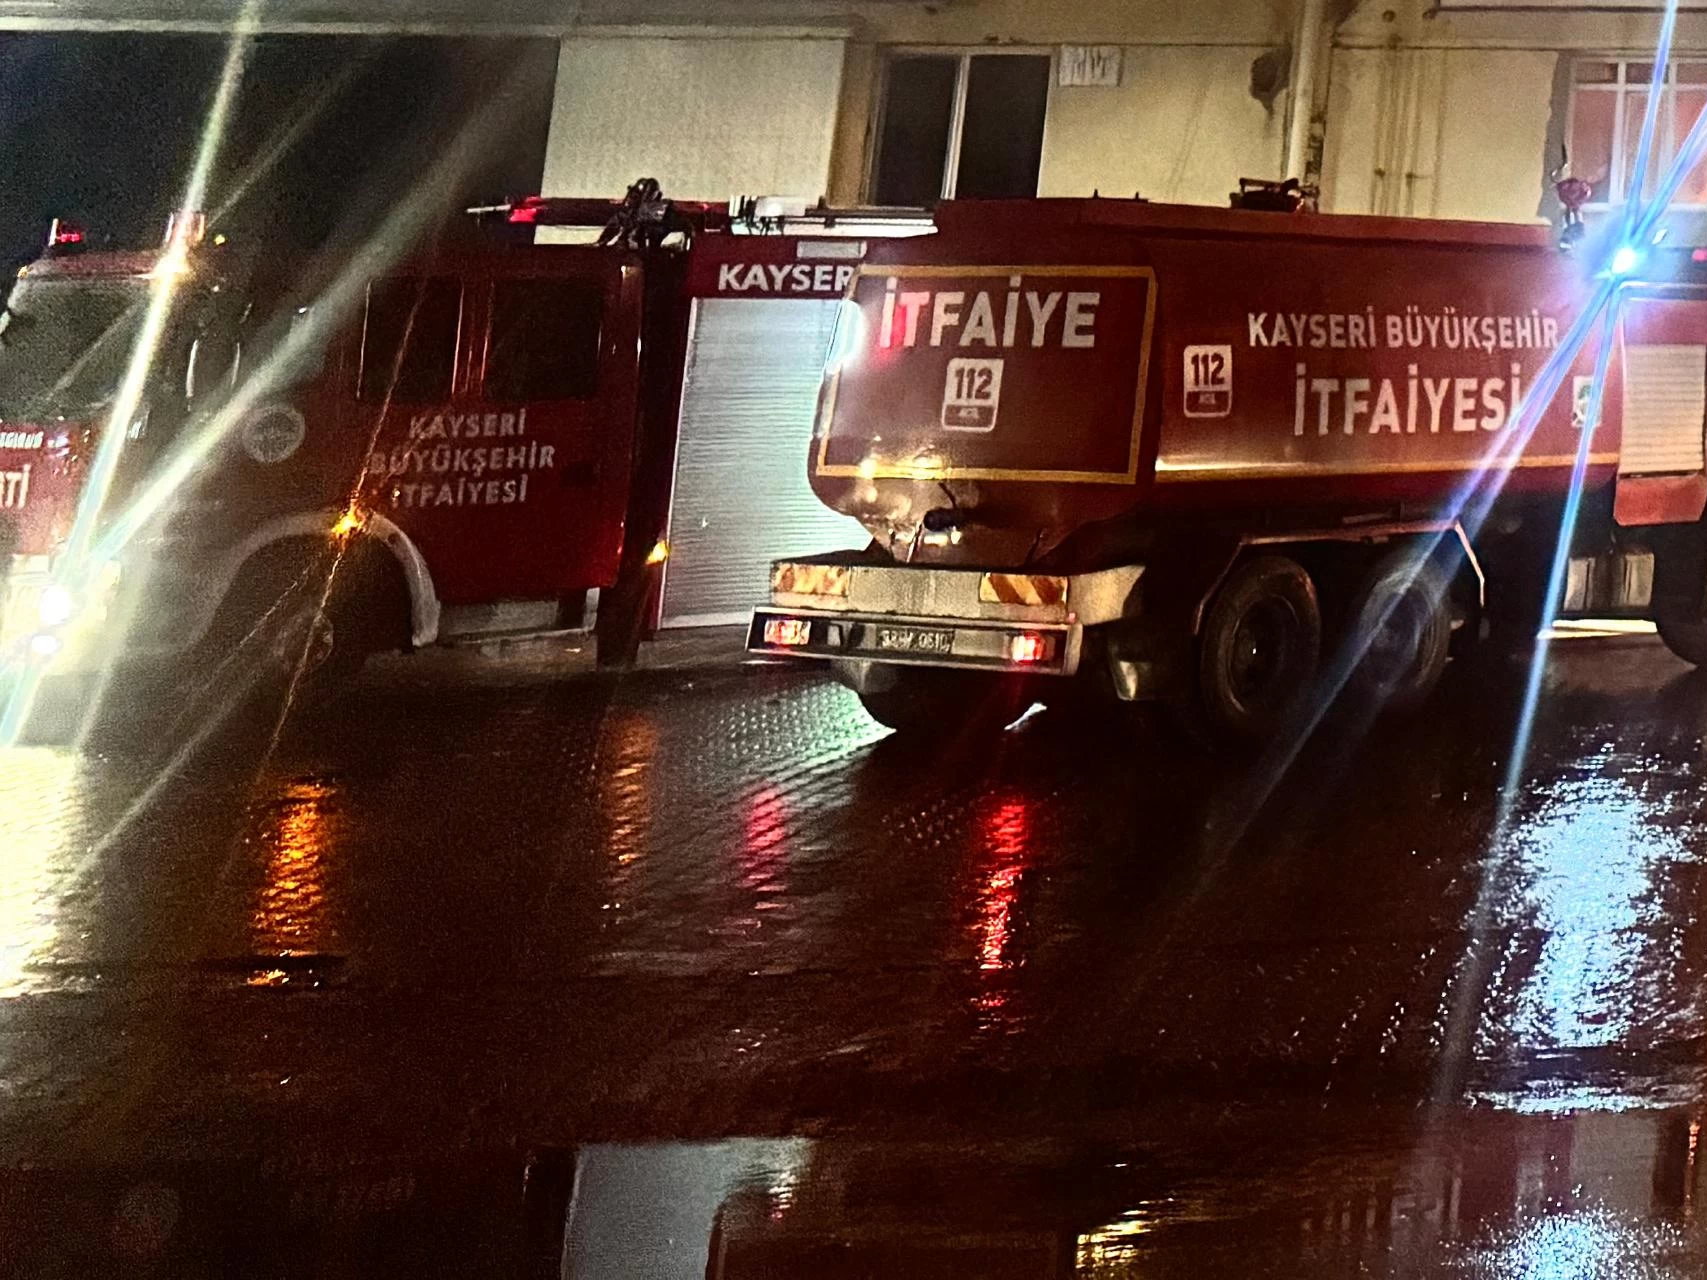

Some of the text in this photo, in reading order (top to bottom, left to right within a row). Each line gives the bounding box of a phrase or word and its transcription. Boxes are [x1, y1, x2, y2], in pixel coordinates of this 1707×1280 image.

[717, 262, 856, 293] KAYSER
[879, 275, 1101, 349] İTFAİYE
[1247, 306, 1560, 354] KAYSERİ BÜYÜKŞEHİR
[955, 366, 994, 401] 112
[1190, 352, 1225, 387] 112
[1293, 362, 1522, 437] İTFAİYESİ
[408, 407, 527, 439] KAYSERİ
[368, 439, 556, 479] BÜYÜKŞEHİR
